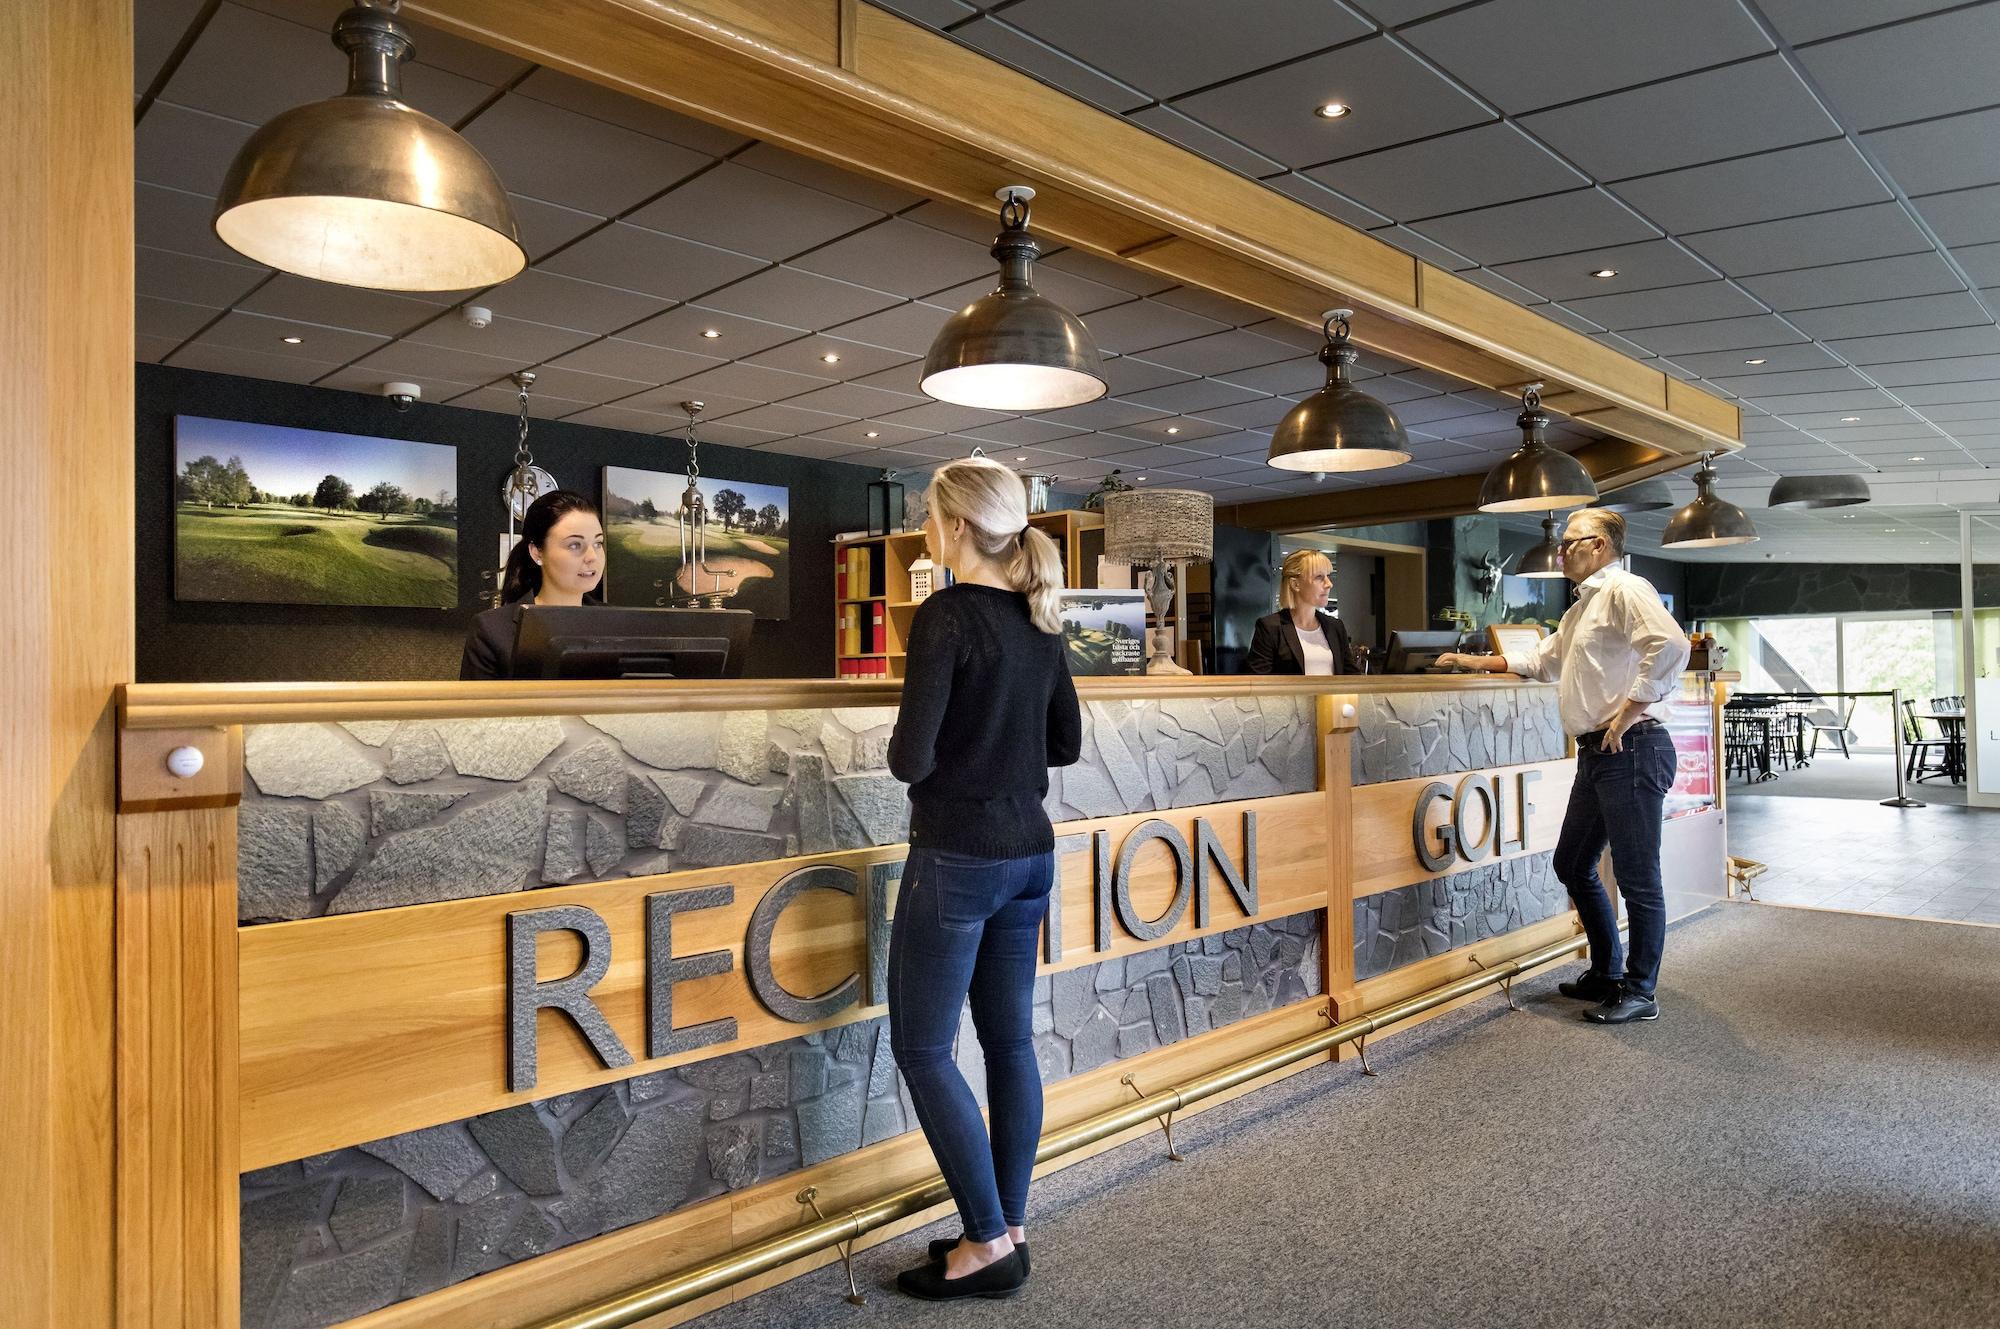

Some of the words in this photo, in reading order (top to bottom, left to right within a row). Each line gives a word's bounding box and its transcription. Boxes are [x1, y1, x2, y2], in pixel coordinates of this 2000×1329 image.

[1112, 656, 1140, 664] golfbanor
[1413, 770, 1542, 872] GOLF
[506, 810, 1258, 1093] RECTION
